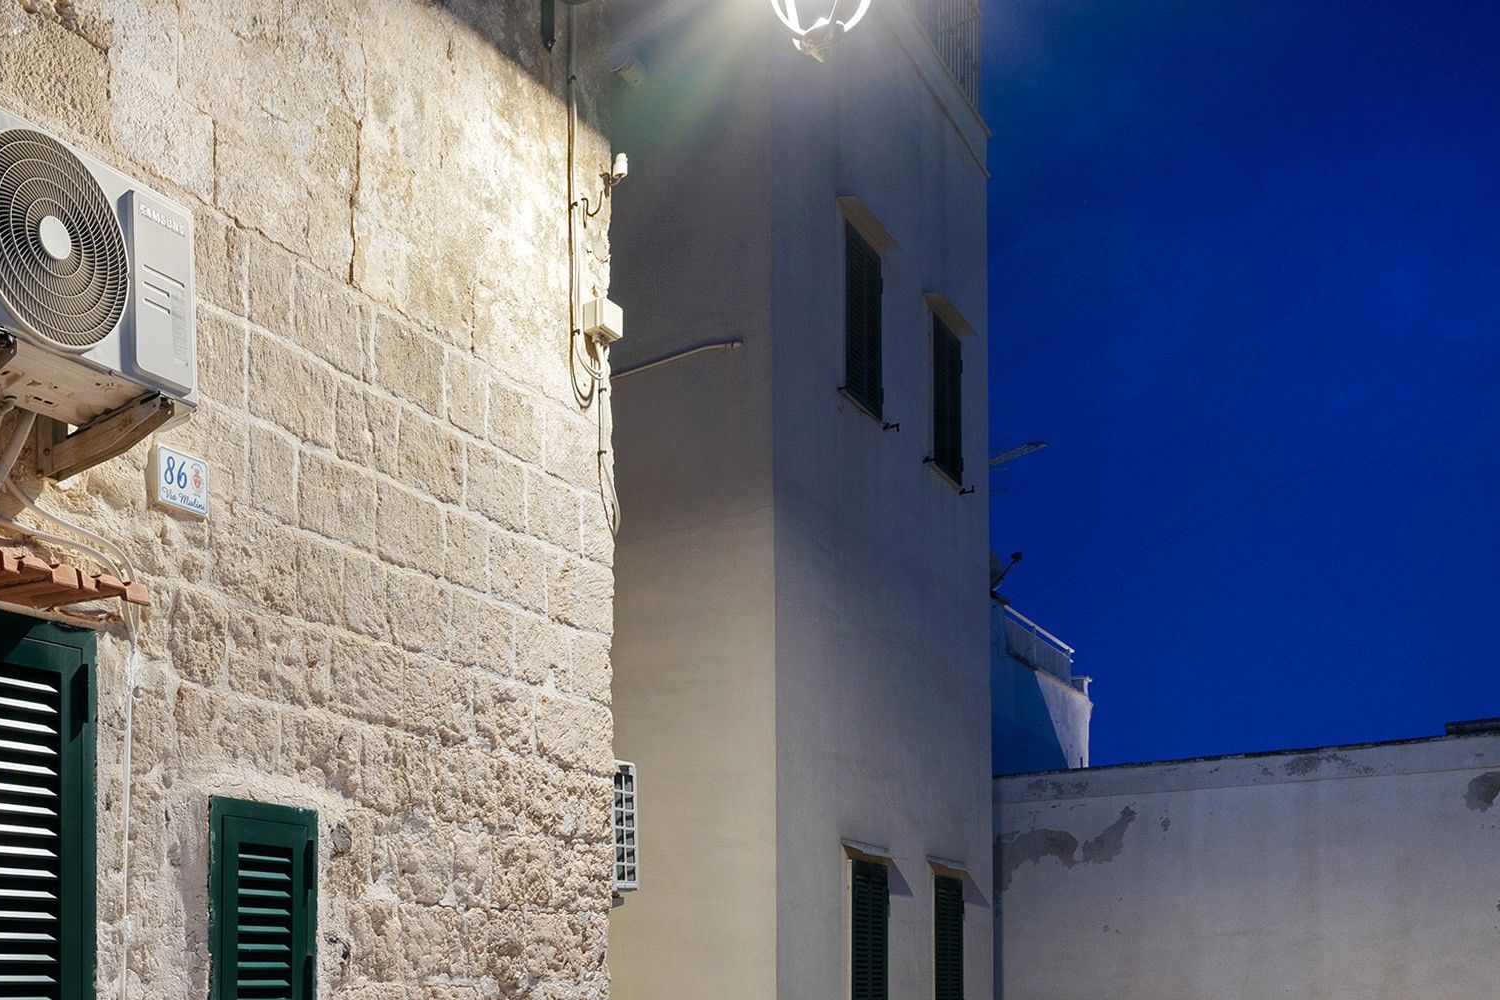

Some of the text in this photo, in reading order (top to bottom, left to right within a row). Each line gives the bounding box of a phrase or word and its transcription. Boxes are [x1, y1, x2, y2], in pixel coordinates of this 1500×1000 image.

[138, 204, 186, 237] SAMSUNG
[164, 456, 187, 489] 86
[162, 487, 178, 501] Via
